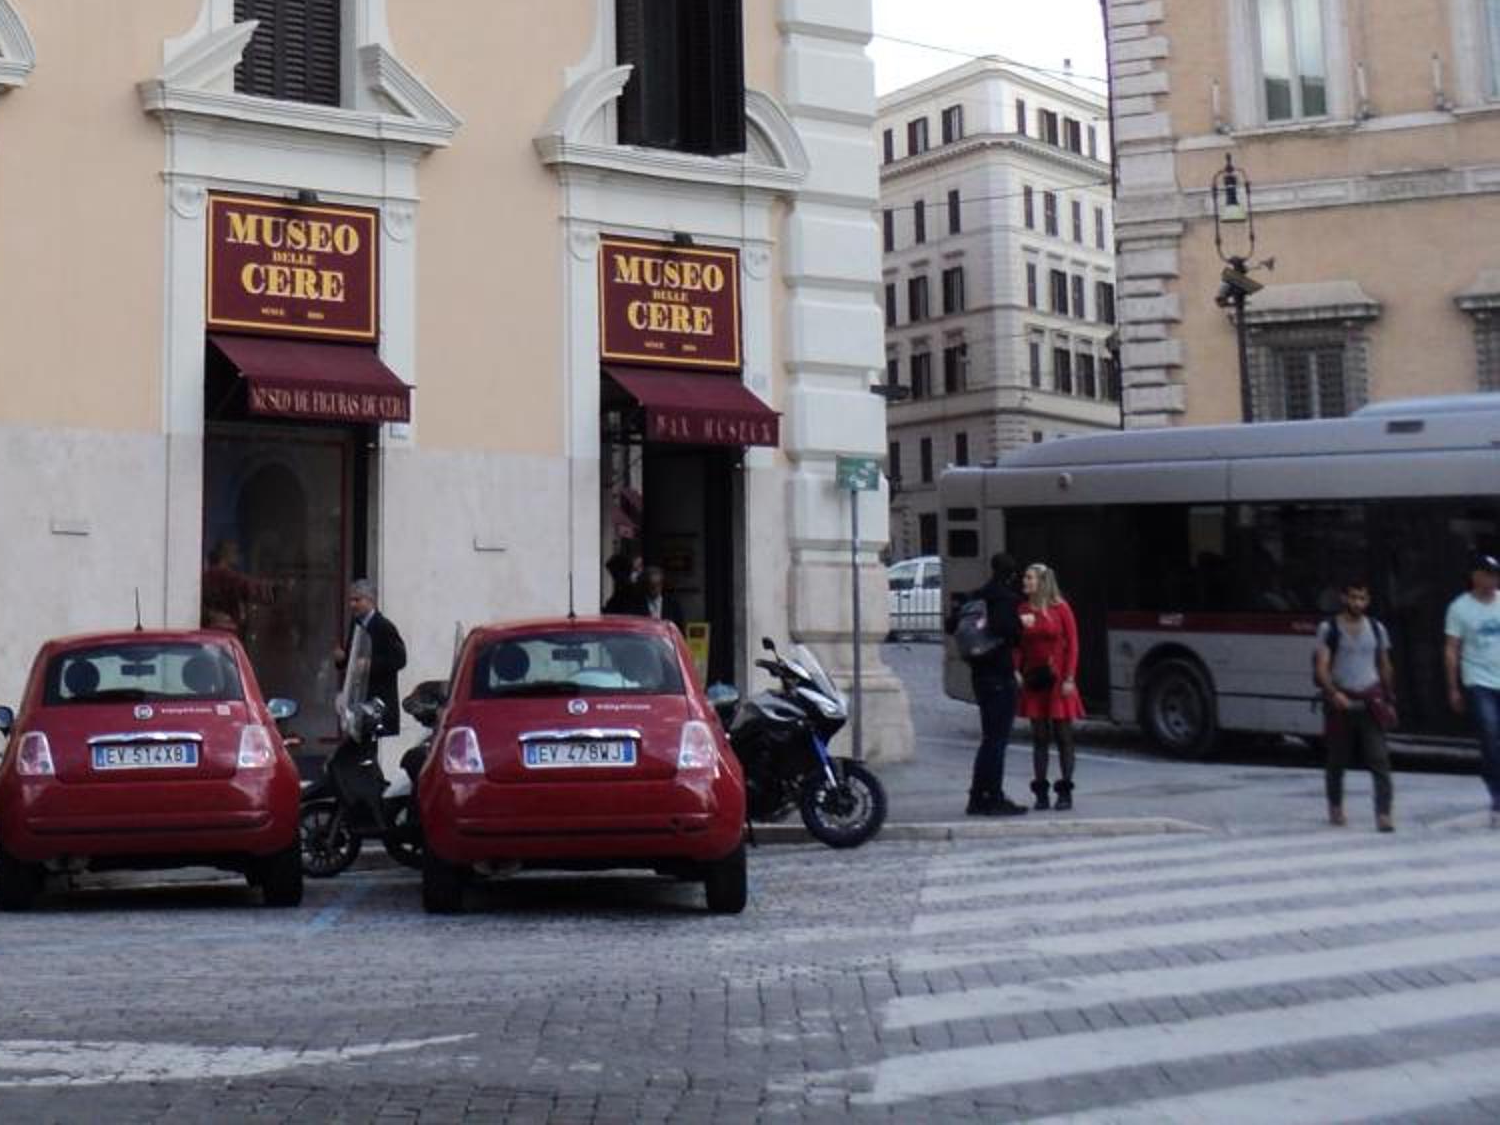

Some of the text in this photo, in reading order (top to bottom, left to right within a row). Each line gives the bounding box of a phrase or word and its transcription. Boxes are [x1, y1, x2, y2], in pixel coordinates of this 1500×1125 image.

[226, 212, 360, 255] MUSEO
[272, 250, 316, 266] DELLE
[613, 254, 725, 292] MUSEO
[241, 262, 346, 302] CERE
[652, 290, 689, 302] DELLE
[627, 300, 713, 335] CERE
[252, 385, 291, 412] MUSEO
[295, 388, 309, 412] DE
[313, 390, 359, 415] FIGURAS
[106, 748, 126, 764] EV
[539, 746, 558, 762] EV
